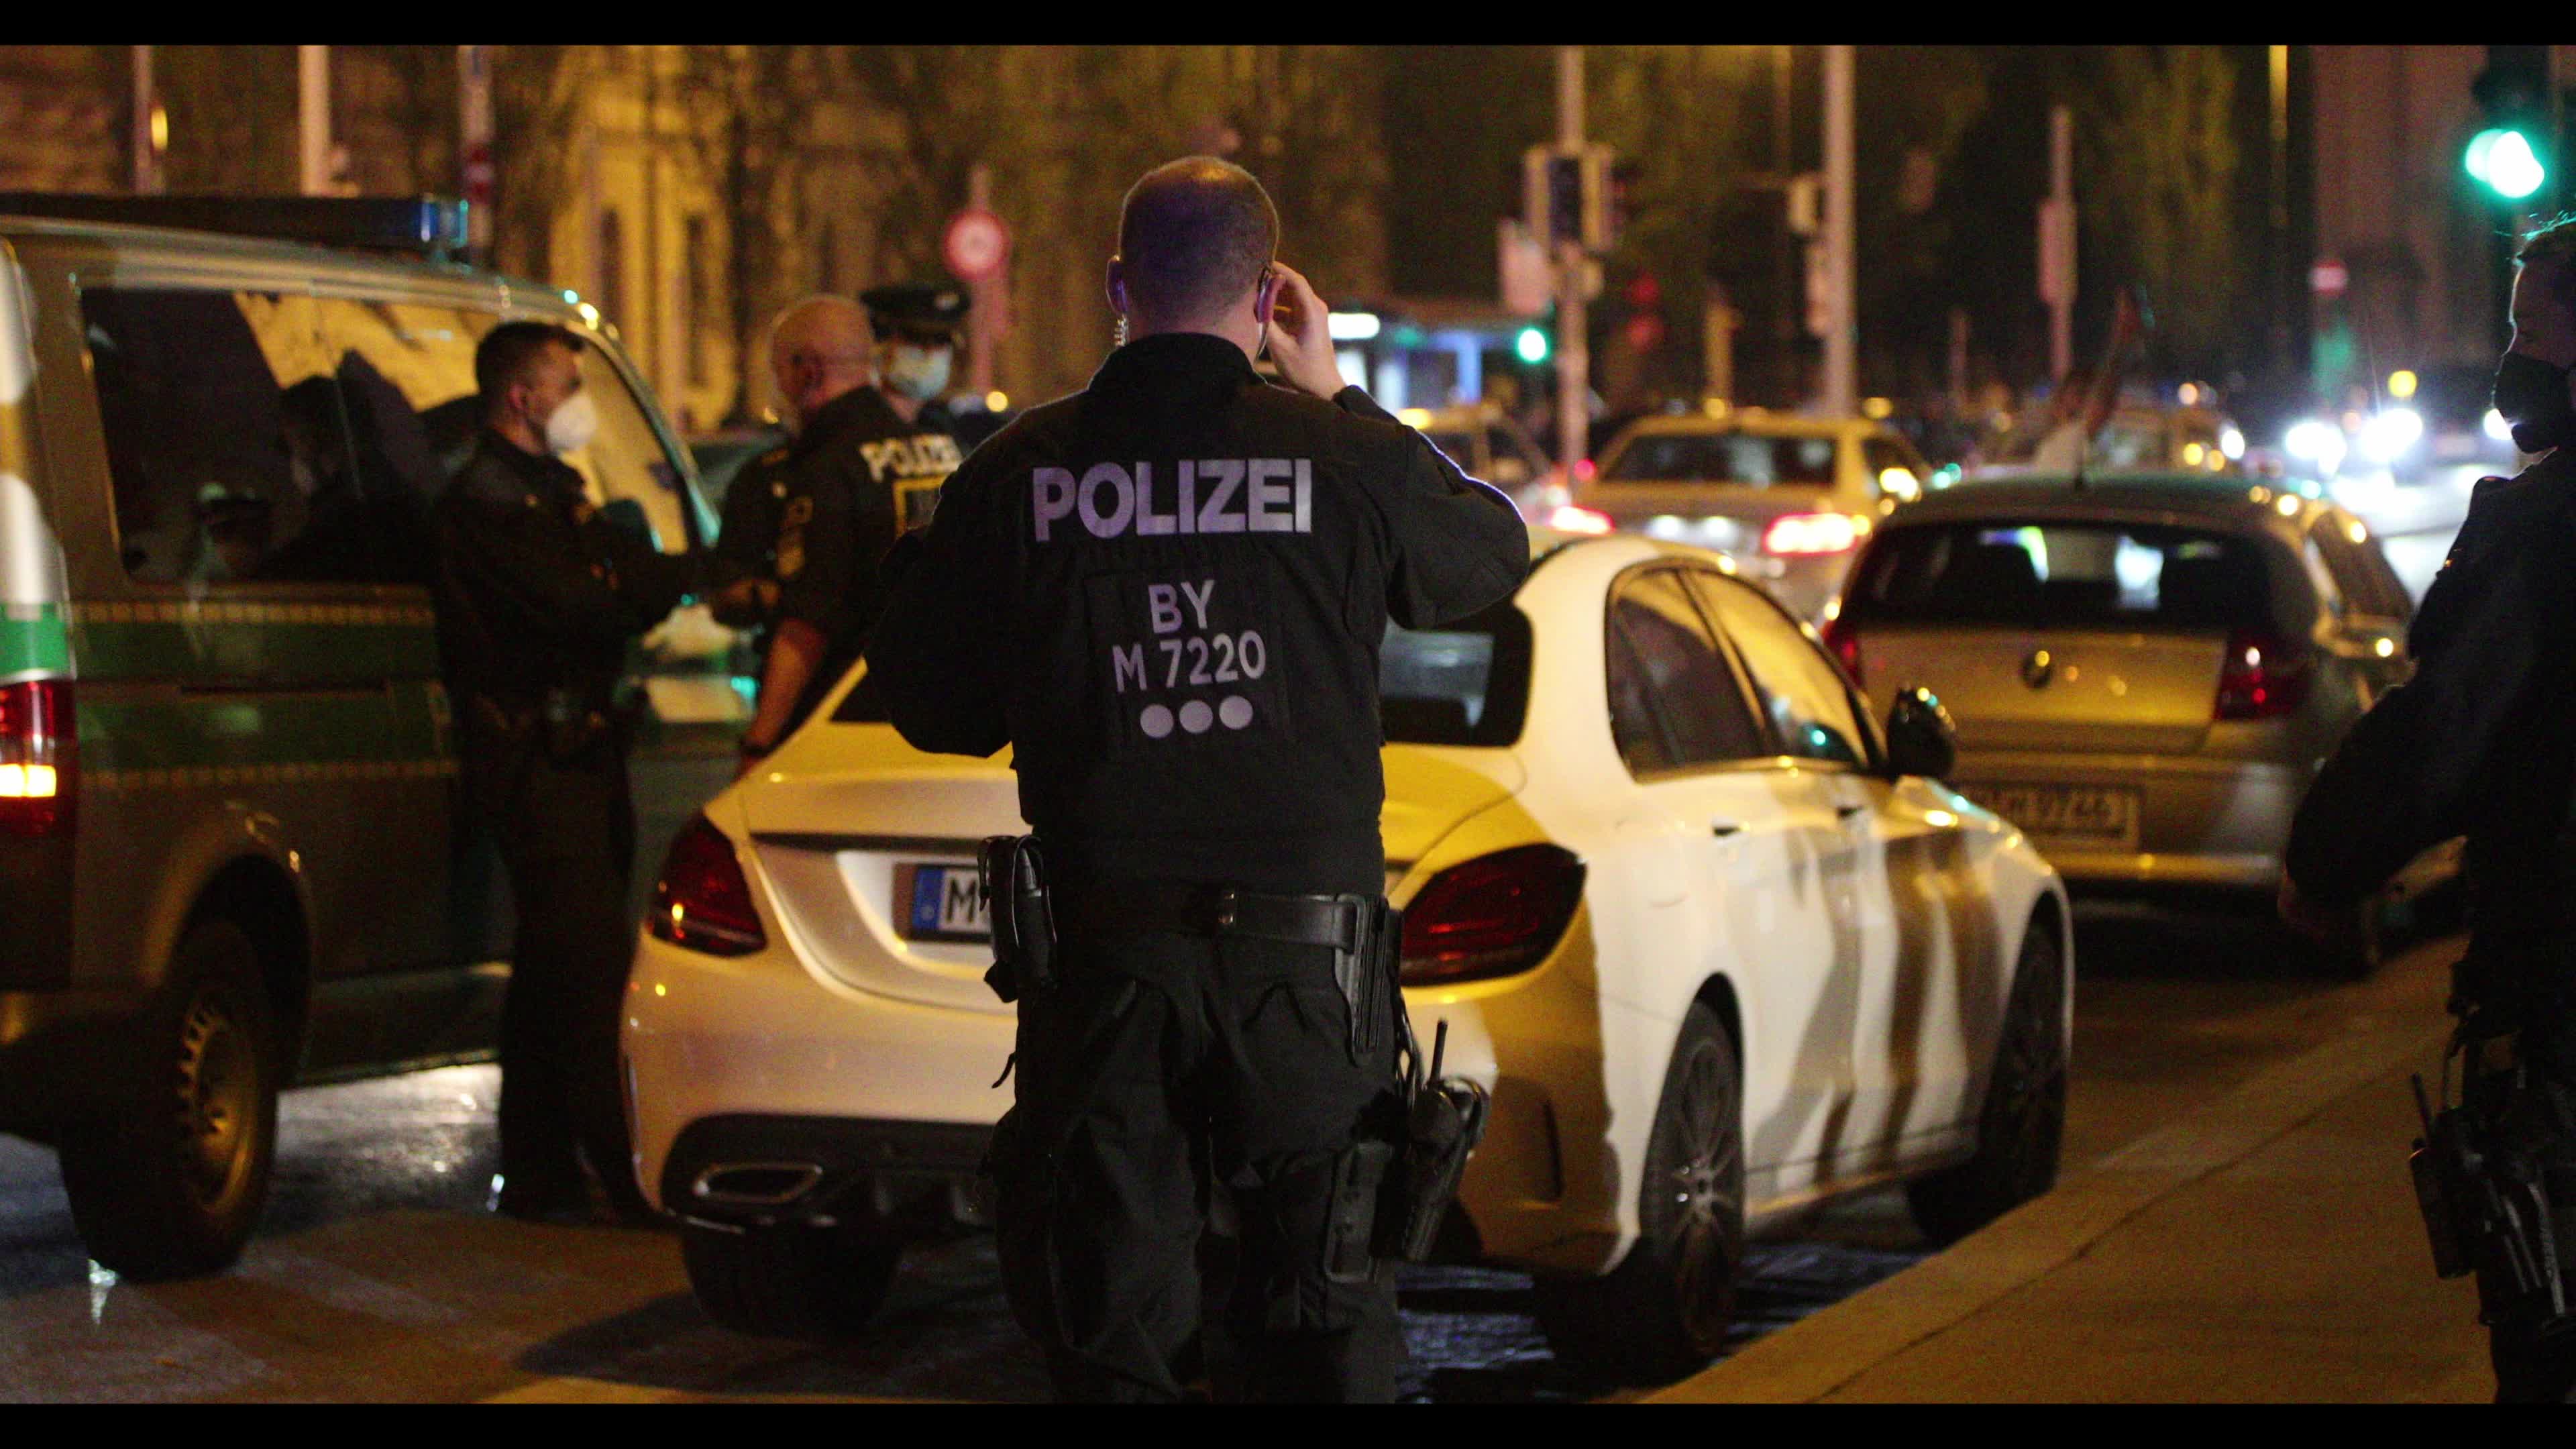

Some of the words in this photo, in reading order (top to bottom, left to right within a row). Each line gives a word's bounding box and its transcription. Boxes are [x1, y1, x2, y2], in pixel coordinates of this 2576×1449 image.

[1032, 459, 1311, 541] POLIZEI
[1148, 580, 1215, 633] BY
[1112, 643, 1147, 692] M
[1159, 630, 1266, 688] 7220
